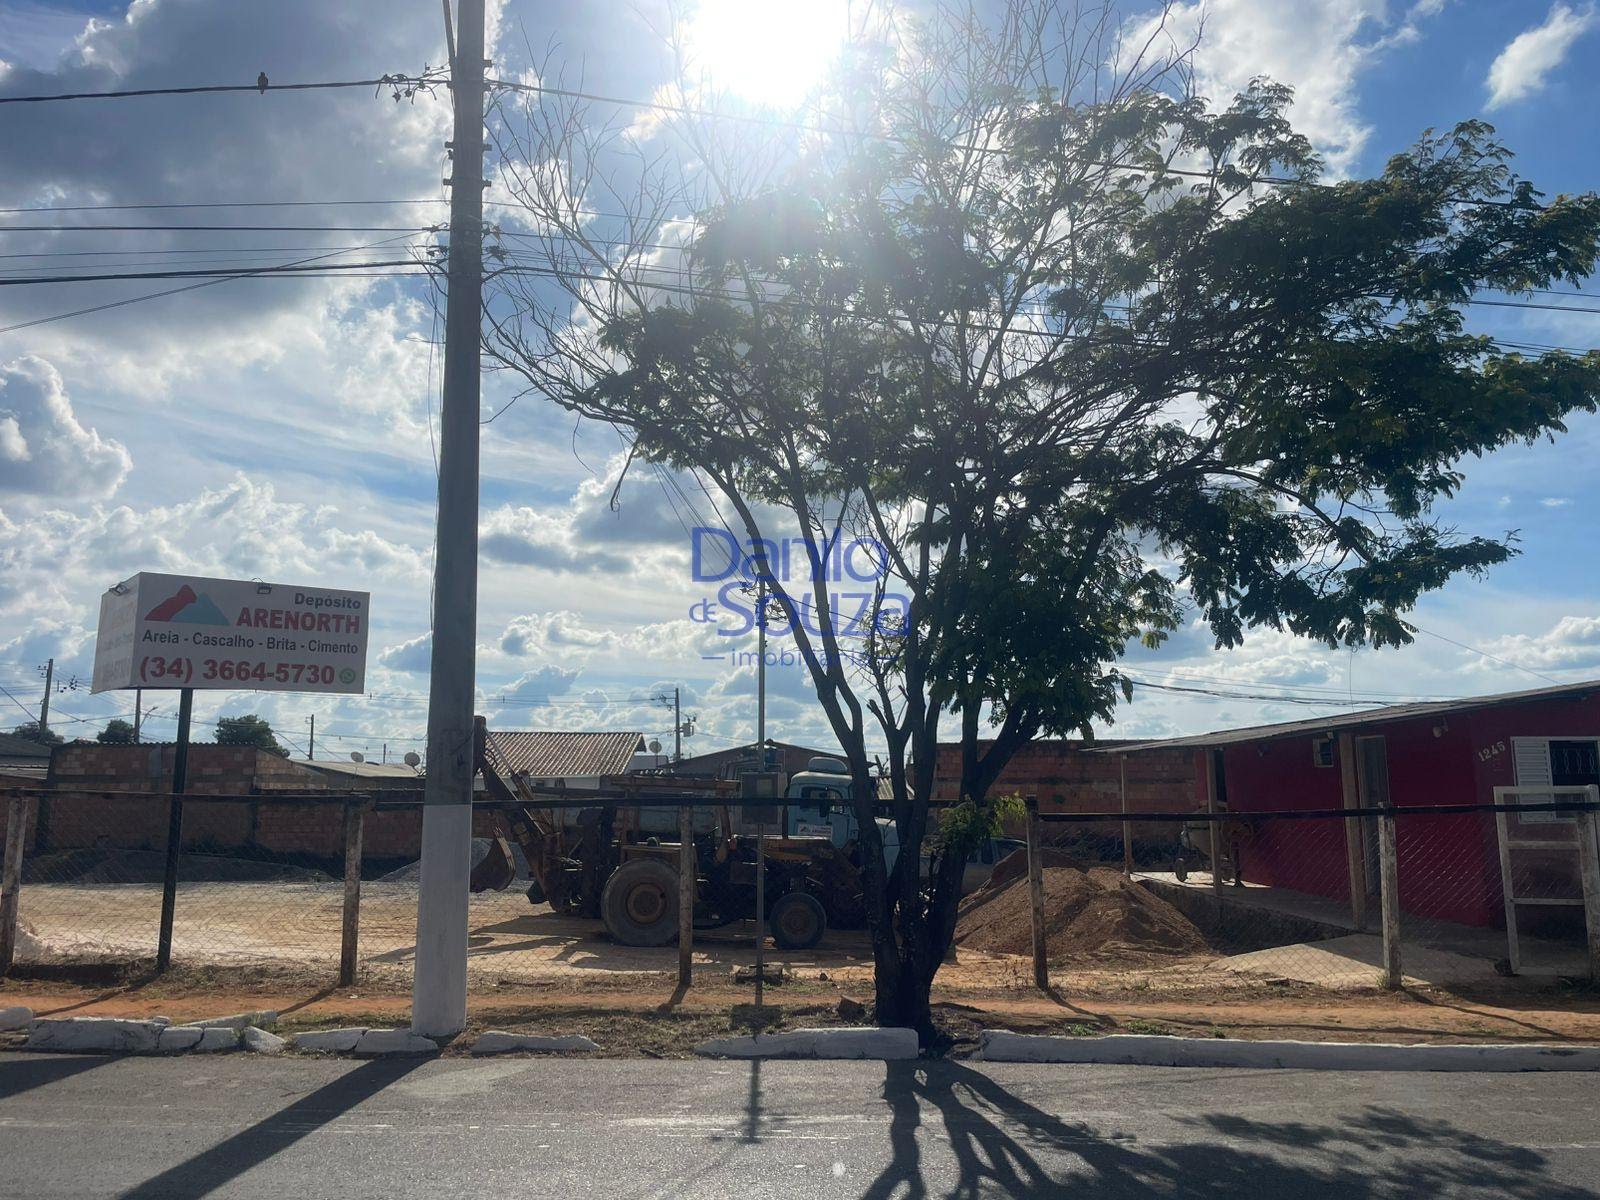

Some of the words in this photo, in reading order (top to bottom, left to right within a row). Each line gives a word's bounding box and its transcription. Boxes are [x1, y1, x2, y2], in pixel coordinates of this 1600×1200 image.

[294, 593, 361, 610] Depósito
[236, 607, 360, 633] ARENORTH
[142, 629, 179, 644] Areia
[192, 632, 254, 649] Cascalho
[267, 636, 296, 651] Brita
[308, 640, 359, 654] Cimento
[139, 656, 193, 683] (34)
[202, 659, 335, 684] 3664-5730
